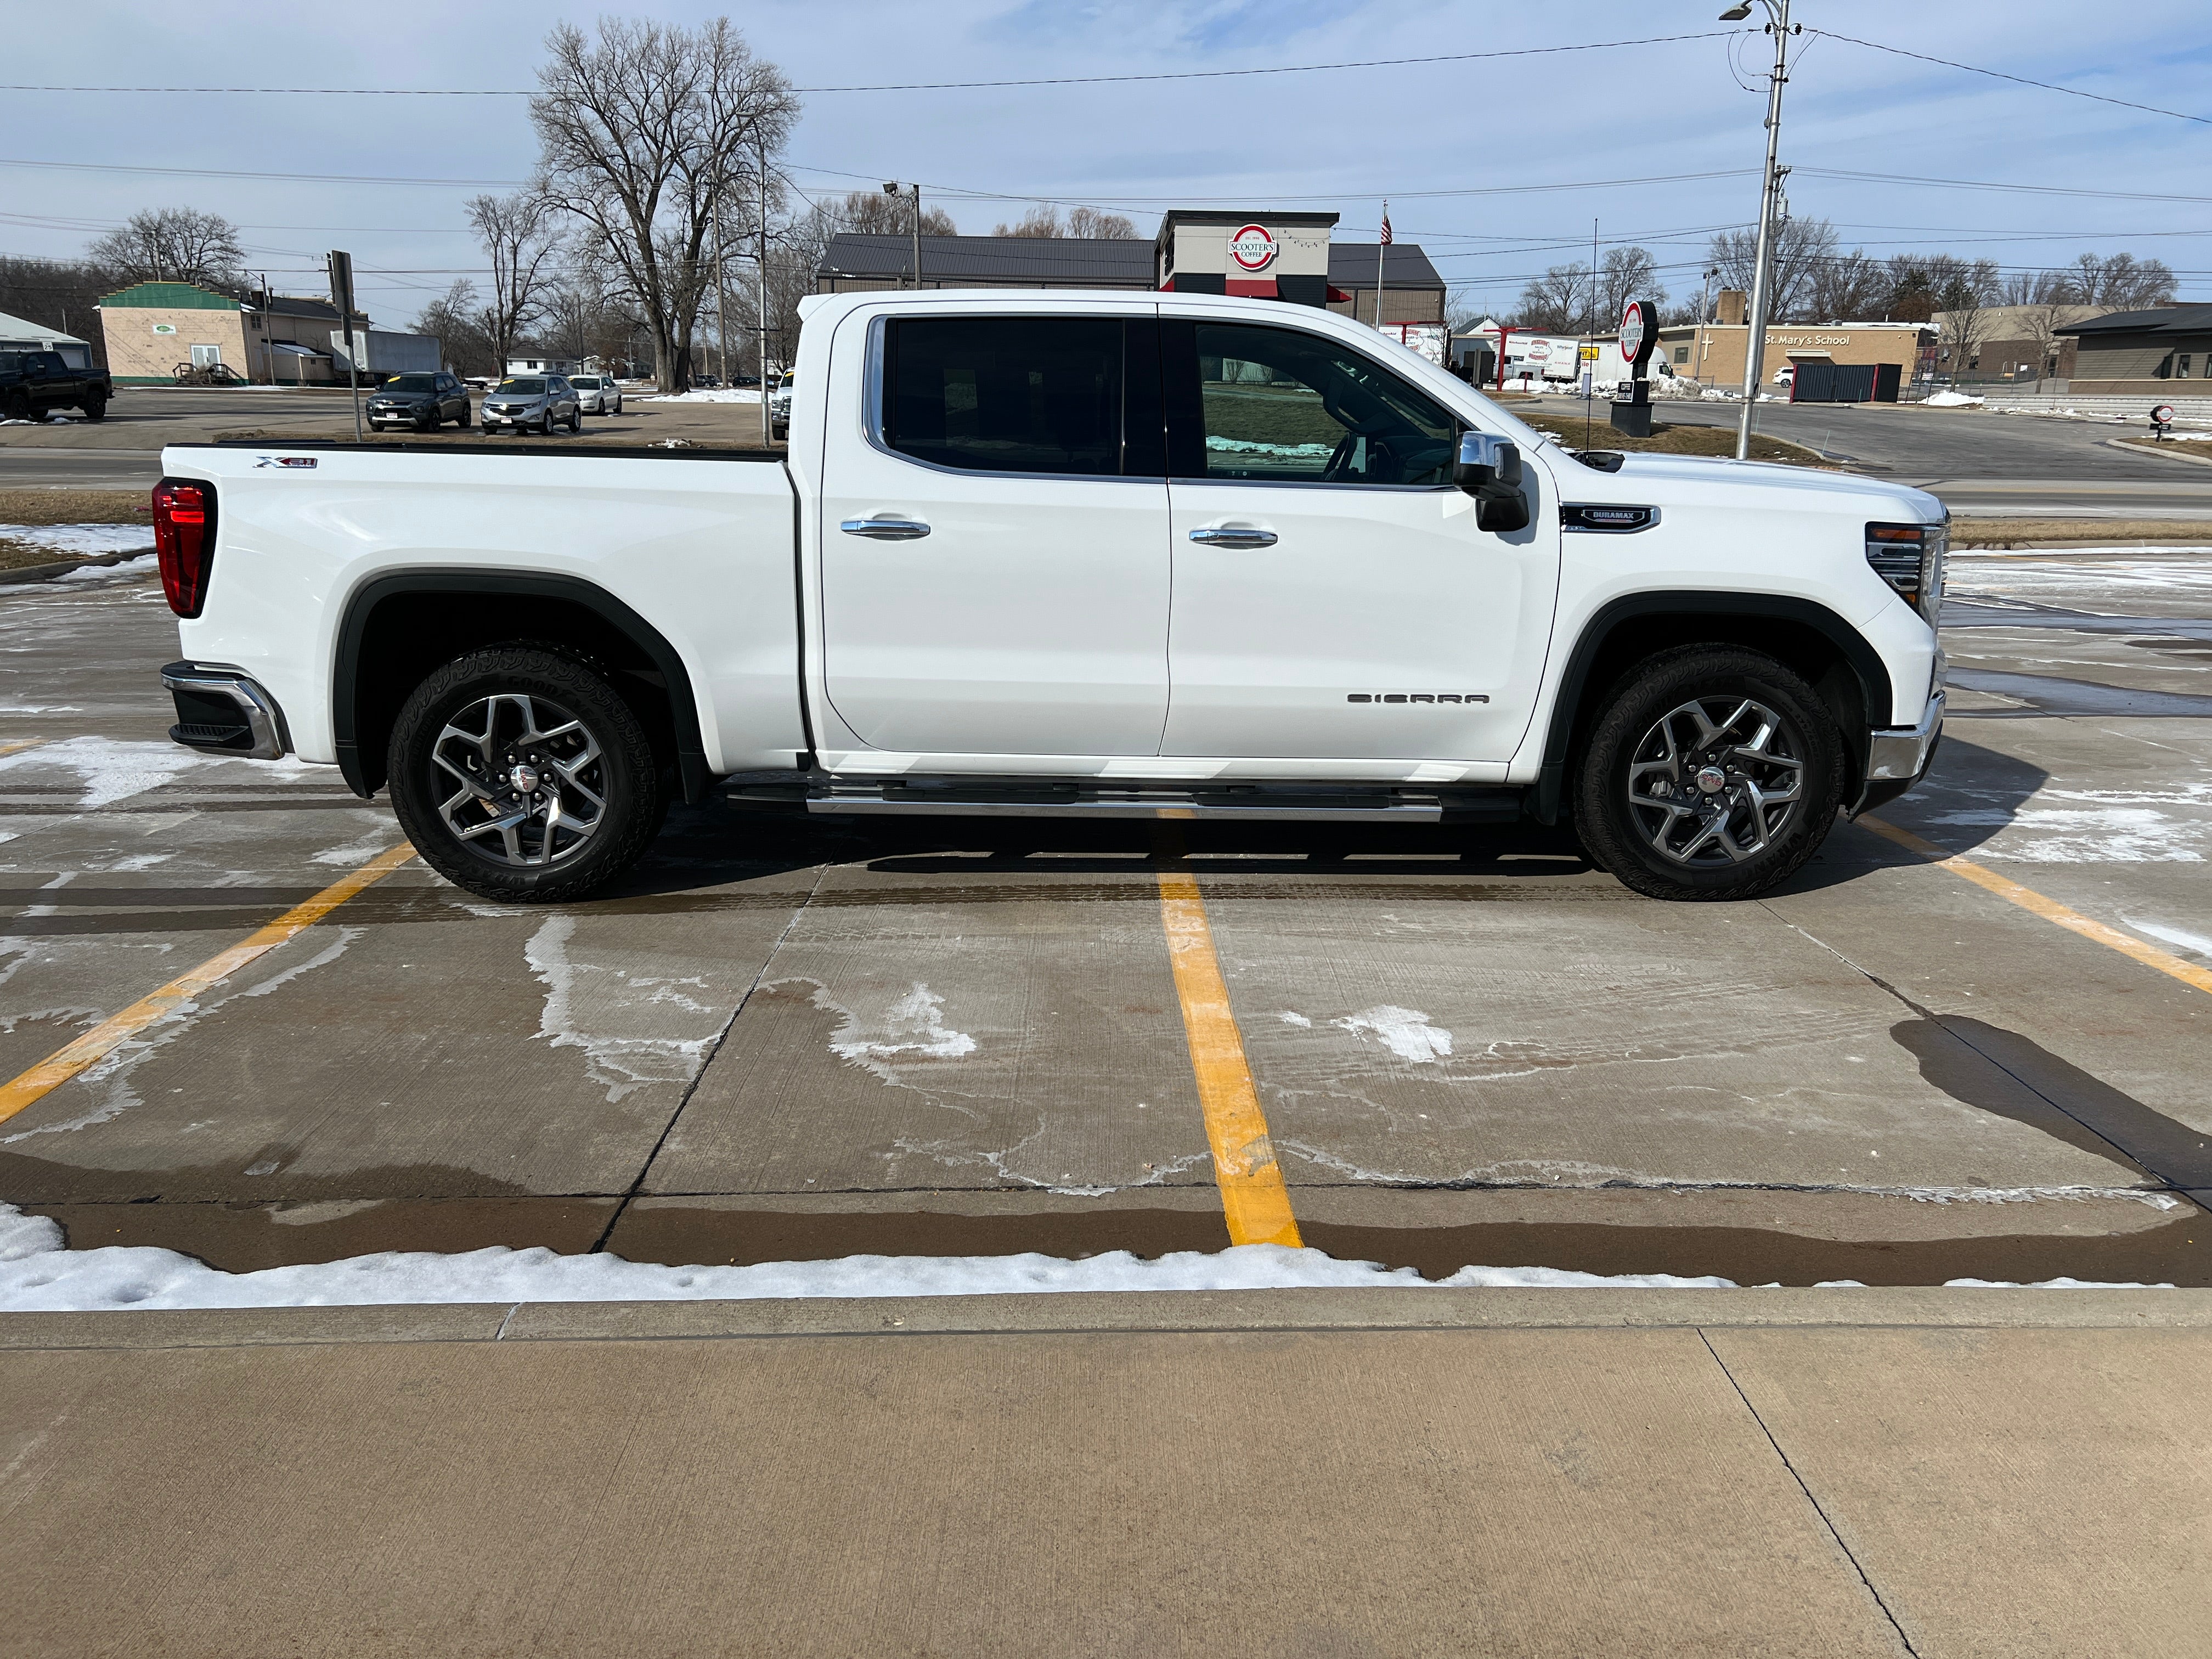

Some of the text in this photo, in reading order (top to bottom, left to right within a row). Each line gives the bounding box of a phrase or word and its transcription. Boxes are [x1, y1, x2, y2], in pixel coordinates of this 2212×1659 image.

[1765, 335, 1850, 347] St. Mary's School
[1347, 694, 1490, 704] SIERRA
[1702, 774, 1722, 786] GMC
